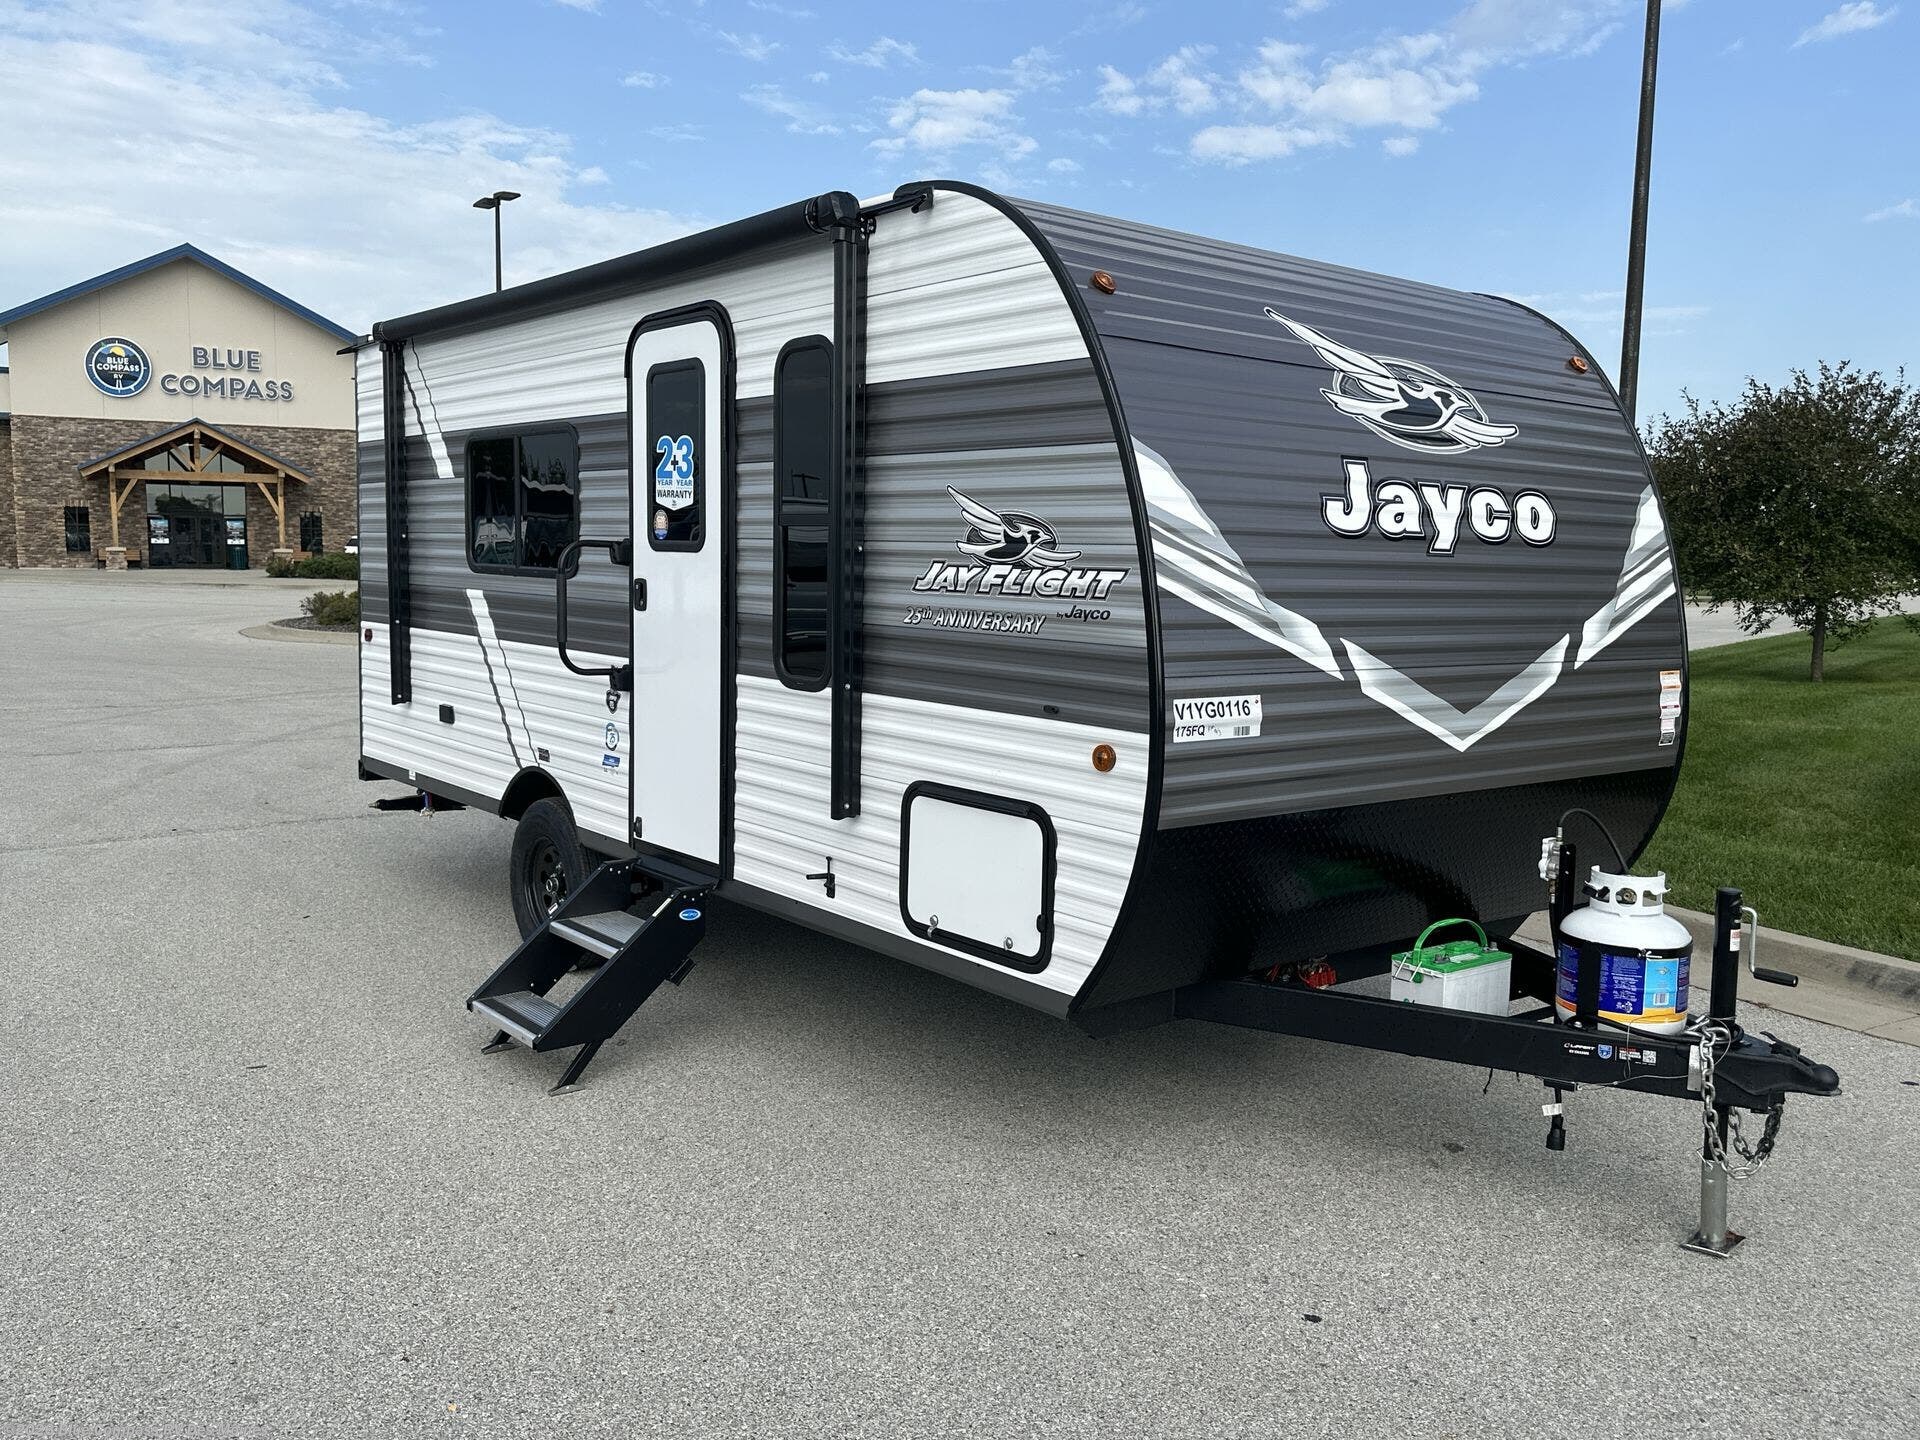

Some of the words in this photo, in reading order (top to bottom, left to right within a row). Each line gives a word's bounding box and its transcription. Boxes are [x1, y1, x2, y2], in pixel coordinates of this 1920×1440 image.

[96, 362, 140, 372] COMPASS
[106, 356, 129, 365] BLUE
[192, 346, 261, 370] BLUE
[160, 374, 293, 400] COMPASS
[676, 479, 693, 487] YEAR
[657, 489, 693, 499] WARRANTY
[1320, 455, 1557, 557] Jayco
[903, 606, 934, 624] 25th
[933, 608, 1047, 635] ANNIVERSARY
[1056, 612, 1065, 620] by
[1064, 604, 1111, 622] Jayco
[1174, 699, 1251, 720] V1YG0116
[1175, 724, 1206, 738] 175FQ
